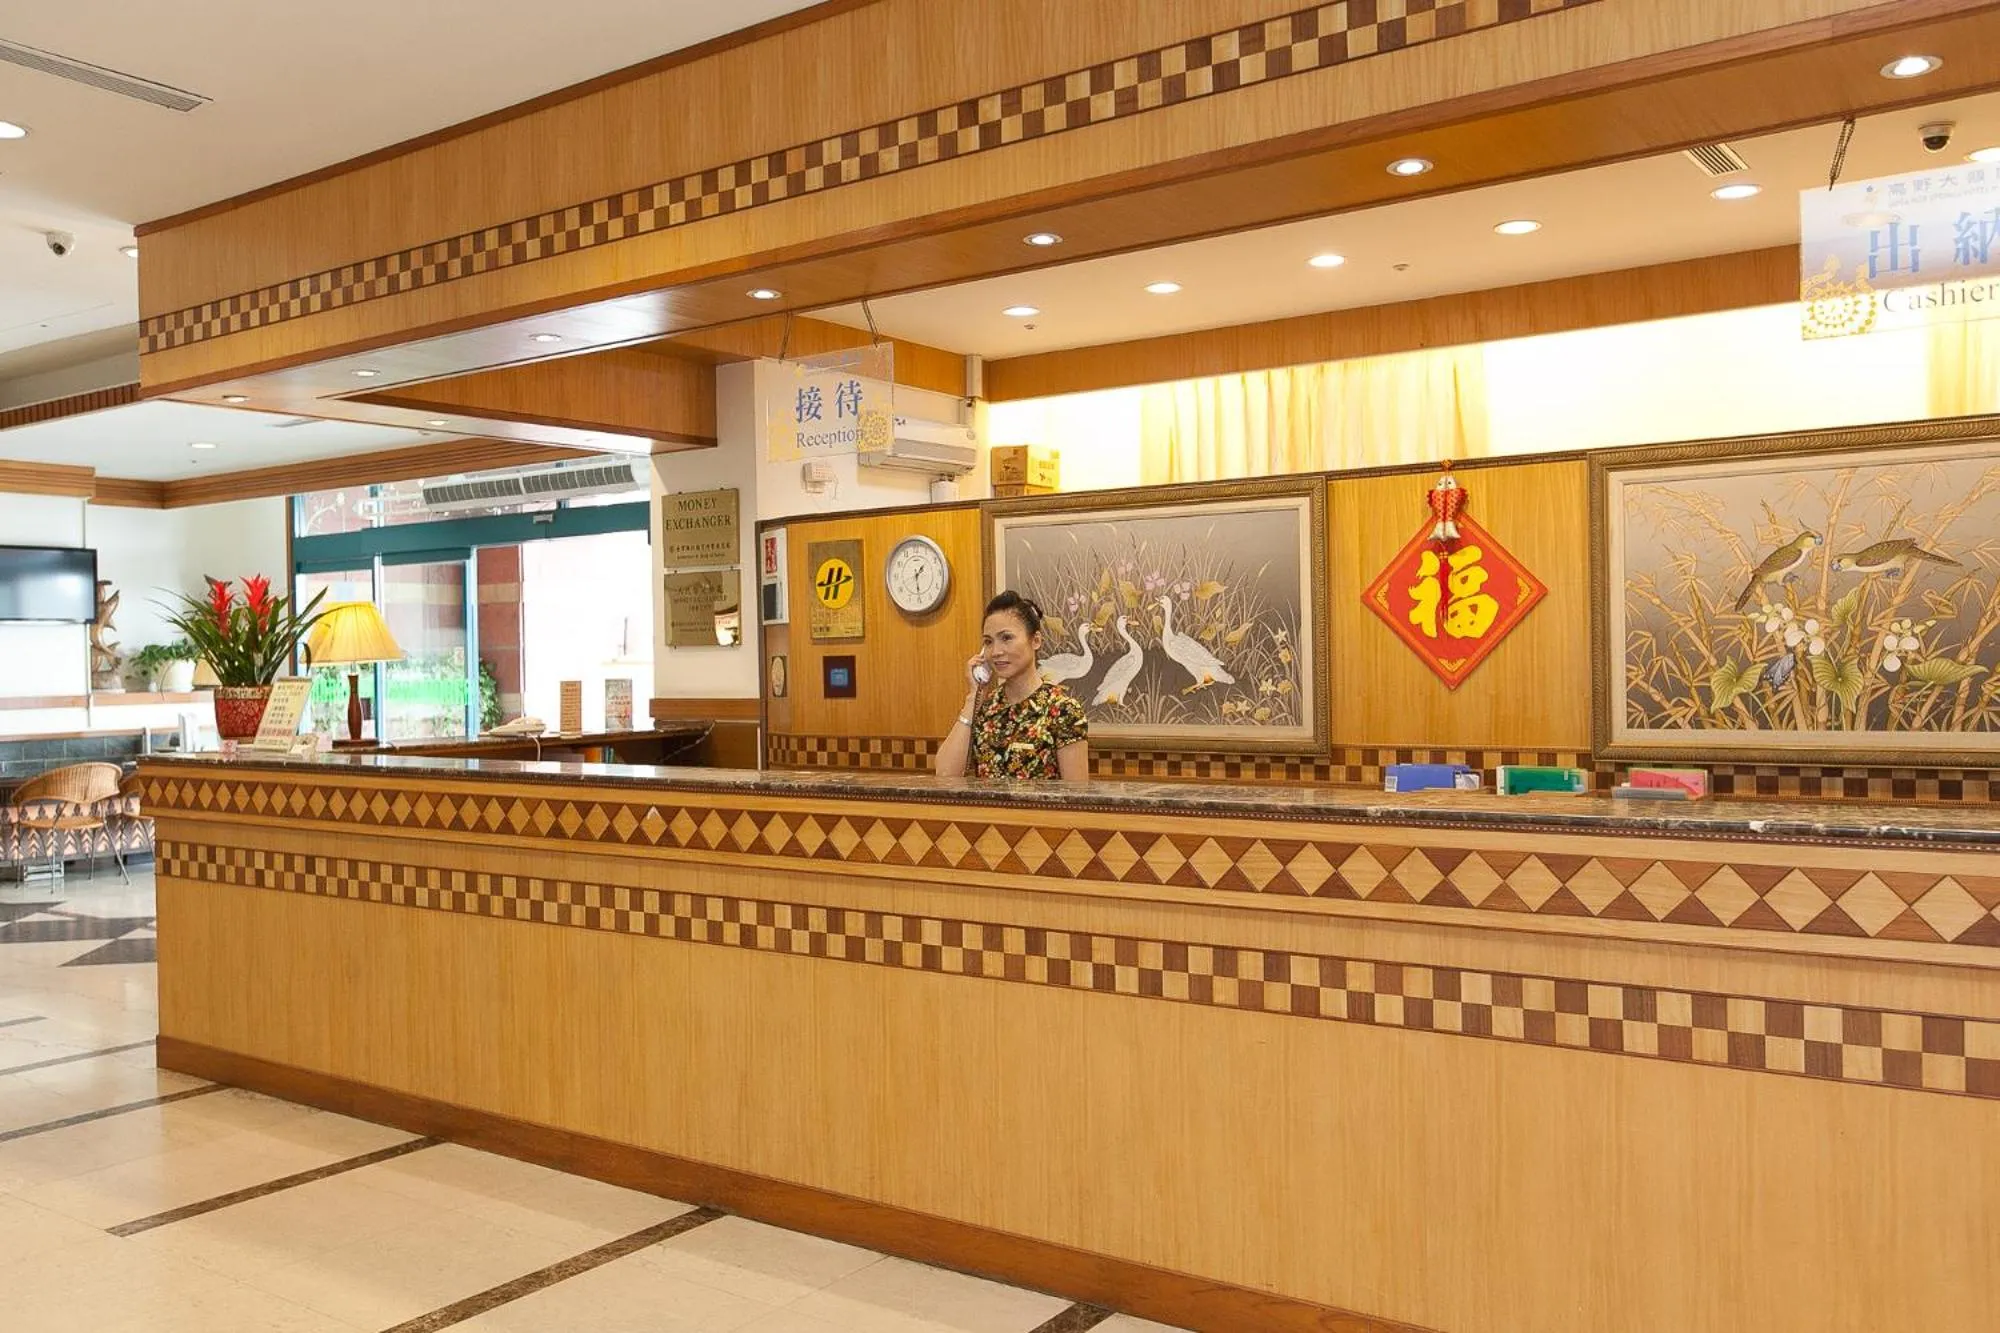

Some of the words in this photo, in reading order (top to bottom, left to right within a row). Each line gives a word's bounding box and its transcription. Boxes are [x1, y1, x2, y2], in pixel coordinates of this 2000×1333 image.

[1883, 279, 2000, 312] Cashier
[795, 380, 863, 424] 接待
[796, 427, 864, 449] Reception
[678, 497, 717, 512] MONEY
[665, 514, 732, 532] EXCHANGER
[1408, 545, 1499, 639] 福
